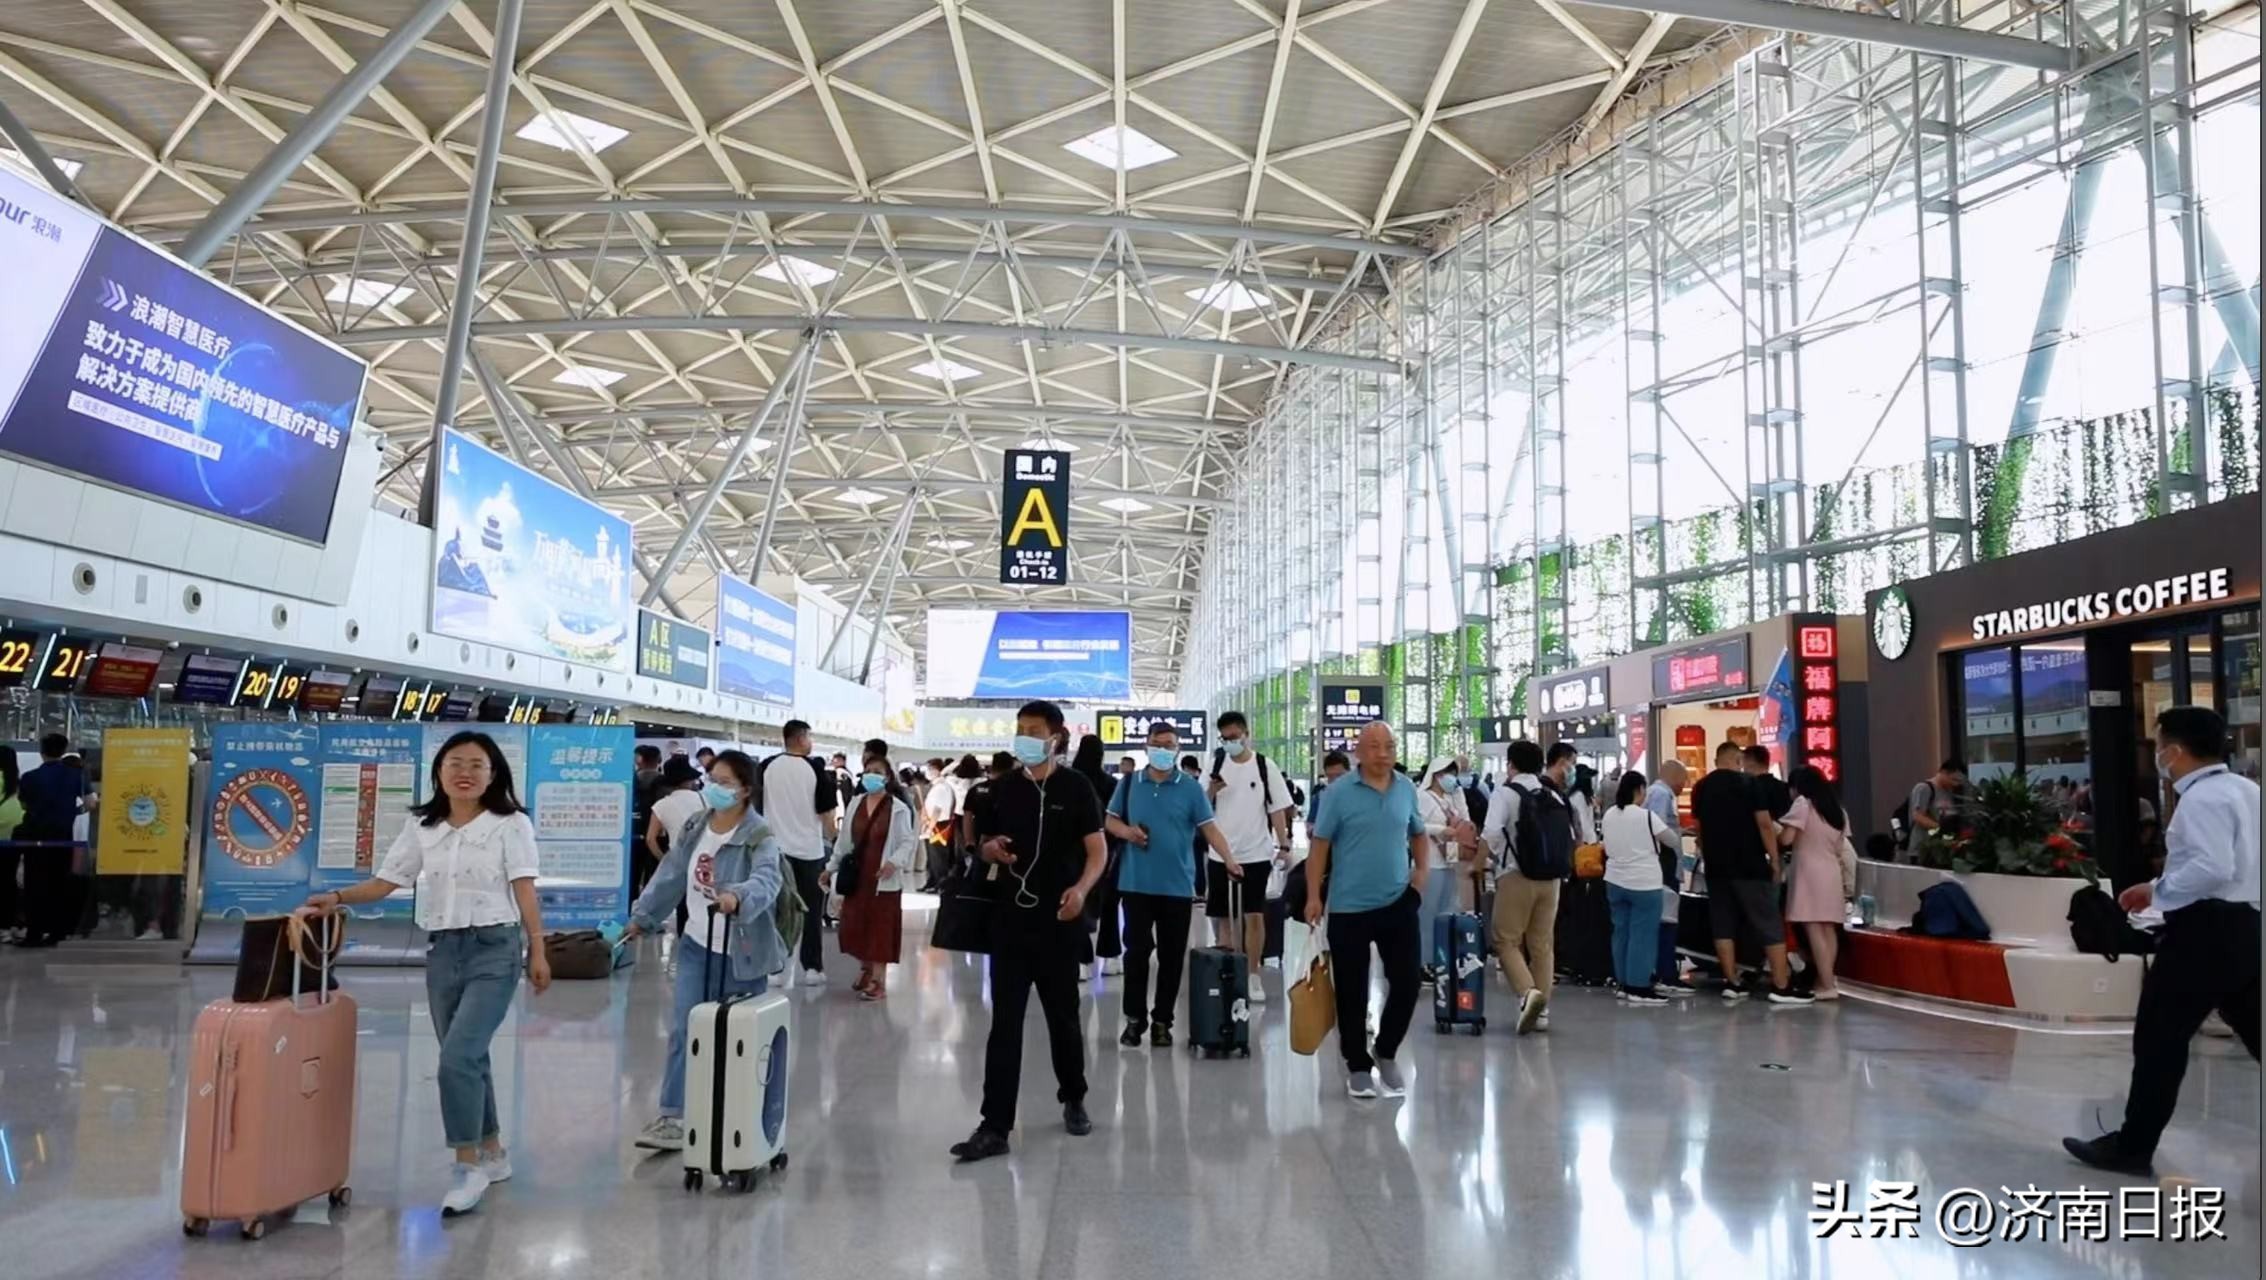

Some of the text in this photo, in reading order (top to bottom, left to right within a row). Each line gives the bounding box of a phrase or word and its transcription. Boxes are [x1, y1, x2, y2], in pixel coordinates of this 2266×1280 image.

[130, 294, 232, 360] 浪潮智慧医疗
[75, 353, 202, 424] 解决方案提供商
[83, 320, 341, 449] 致力于成为国内领先的智慧医疗产品与
[1016, 455, 1057, 474] 国内
[1016, 473, 1055, 481] Domestic
[1007, 488, 1062, 547] A
[1009, 566, 1058, 579] 01-12
[1973, 567, 2229, 641] STARBUCKS COFFEE
[0, 641, 30, 672] 22
[51, 648, 84, 677] 21
[243, 671, 268, 697] 20
[277, 676, 299, 699] 19
[402, 690, 417, 712] 18
[426, 692, 442, 713] 17
[551, 746, 614, 765] 温馨提示
